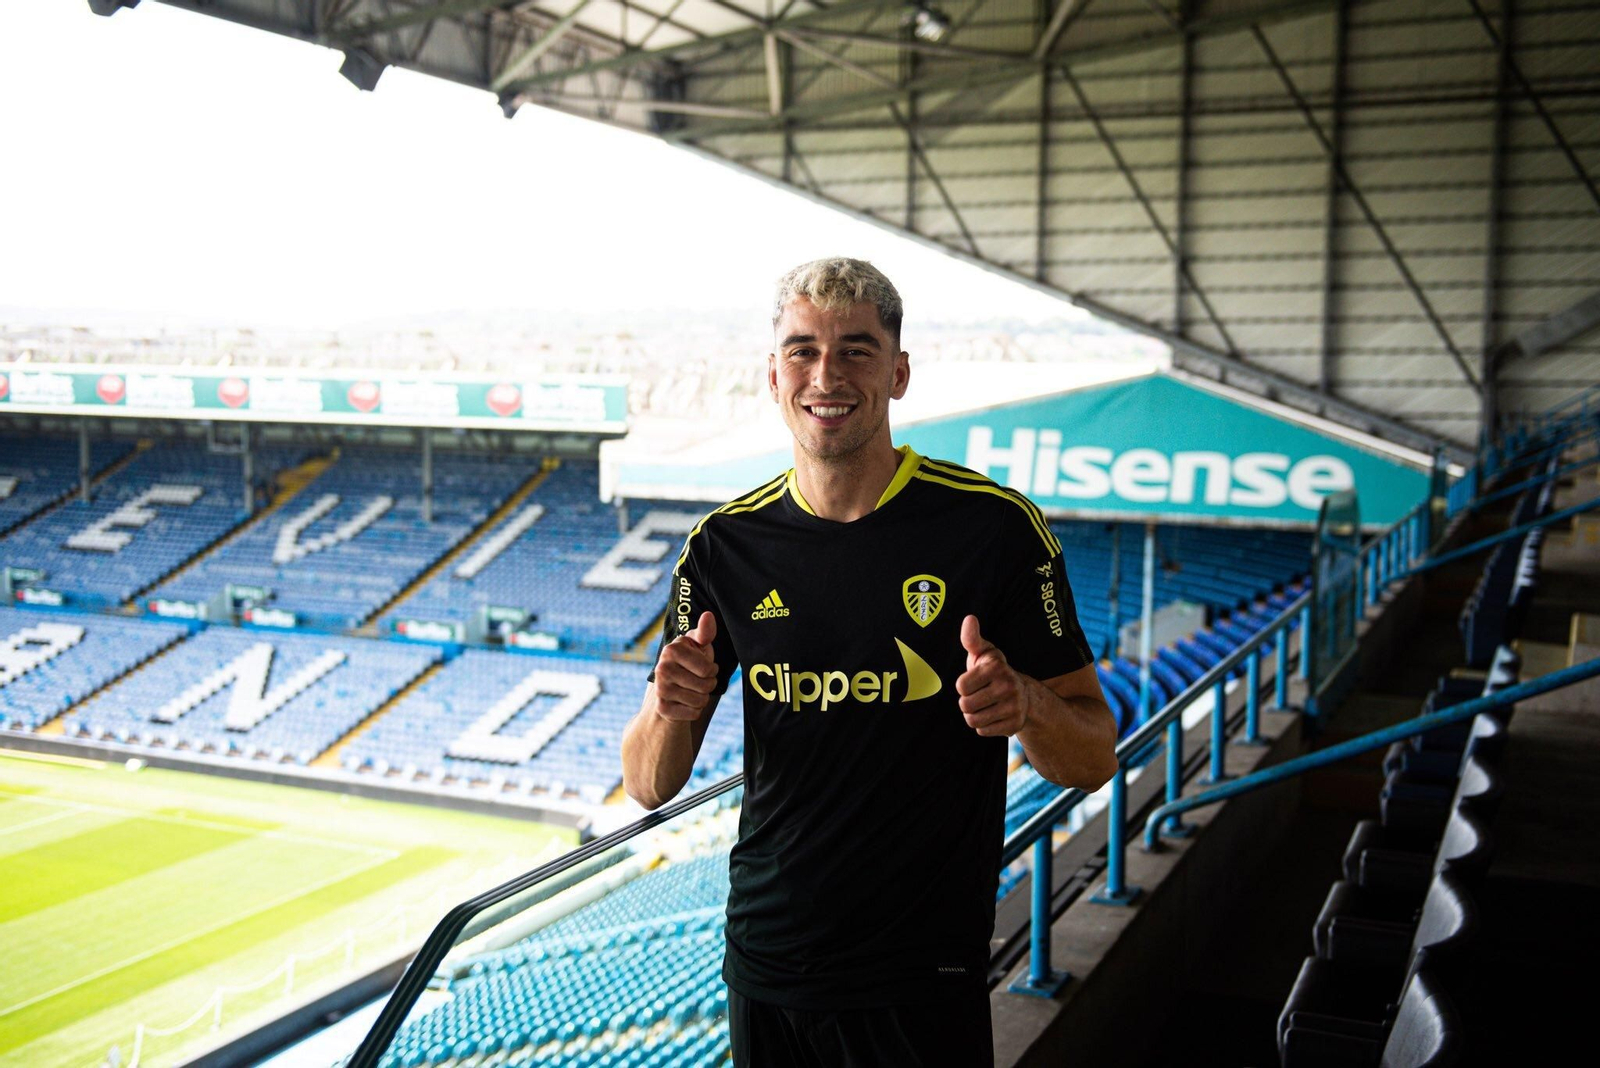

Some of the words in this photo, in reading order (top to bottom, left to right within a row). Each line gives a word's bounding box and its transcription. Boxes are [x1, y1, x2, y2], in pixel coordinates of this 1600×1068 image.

[964, 425, 1356, 511] Hisense
[677, 576, 692, 632] SBOTOP
[751, 606, 790, 621] adidas
[1040, 581, 1063, 638] SBOTOP
[749, 662, 898, 712] Clipper
